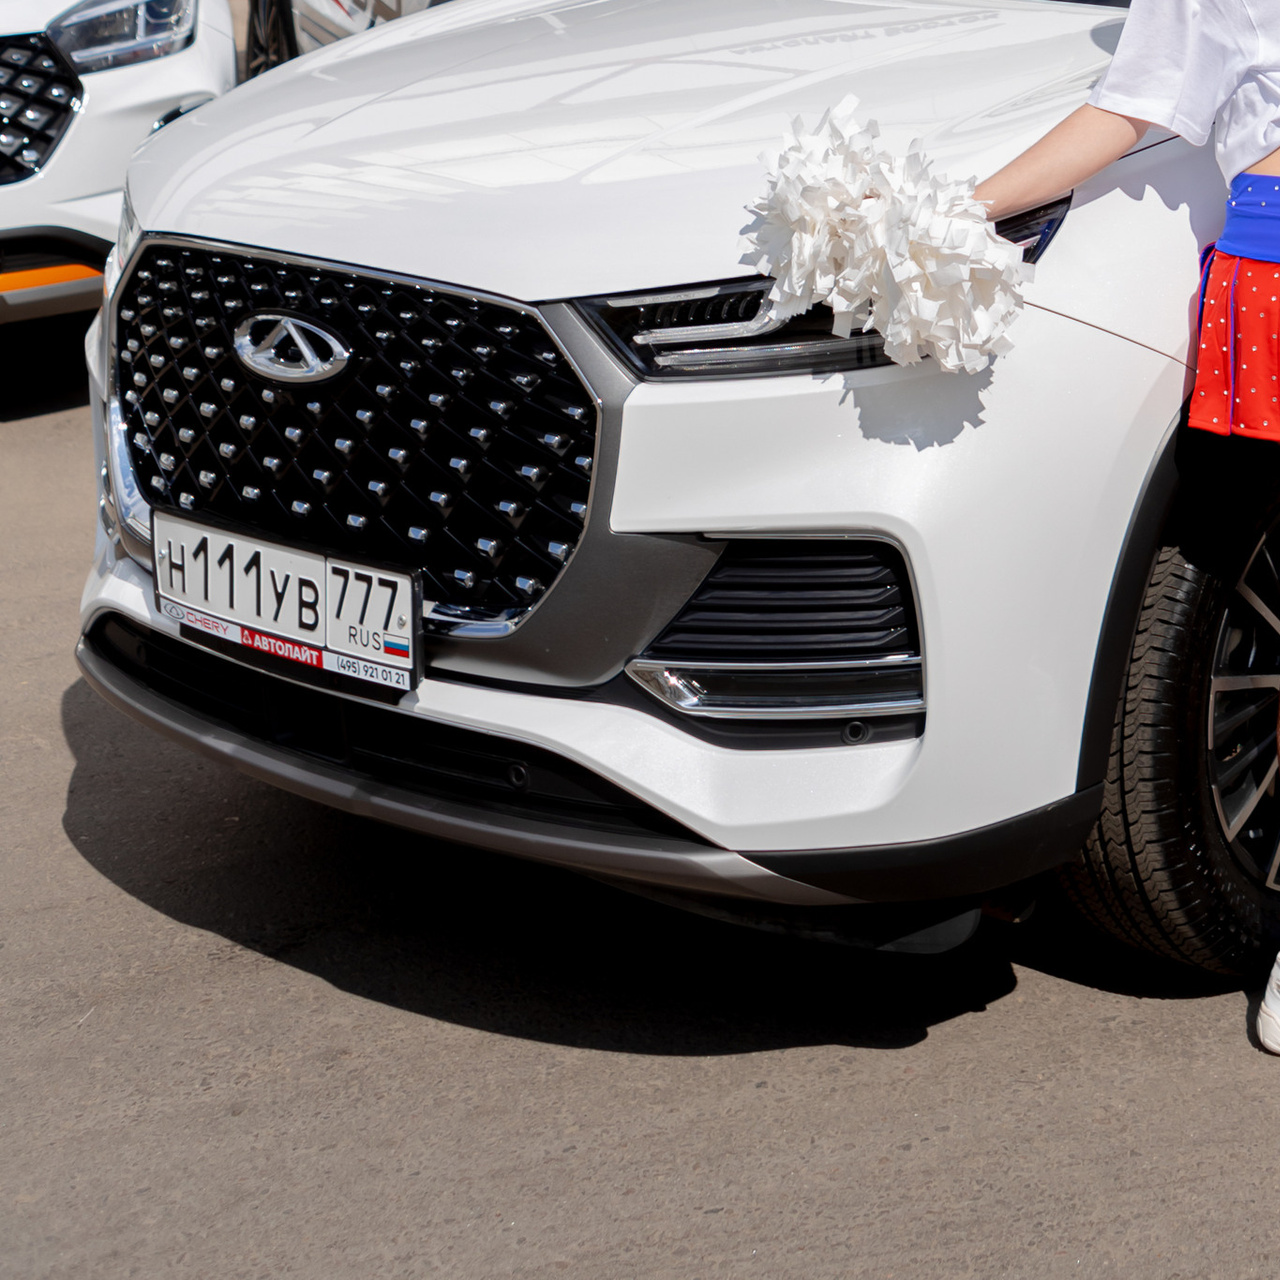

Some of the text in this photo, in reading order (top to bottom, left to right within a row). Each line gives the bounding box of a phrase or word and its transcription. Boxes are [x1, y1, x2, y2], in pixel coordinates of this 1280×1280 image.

[331, 565, 399, 632] 777
[185, 611, 230, 636] CHERY
[348, 625, 382, 651] RUS
[253, 633, 320, 666] АВТОЛАЙТ
[336, 655, 406, 686] (495) 921 01 21
